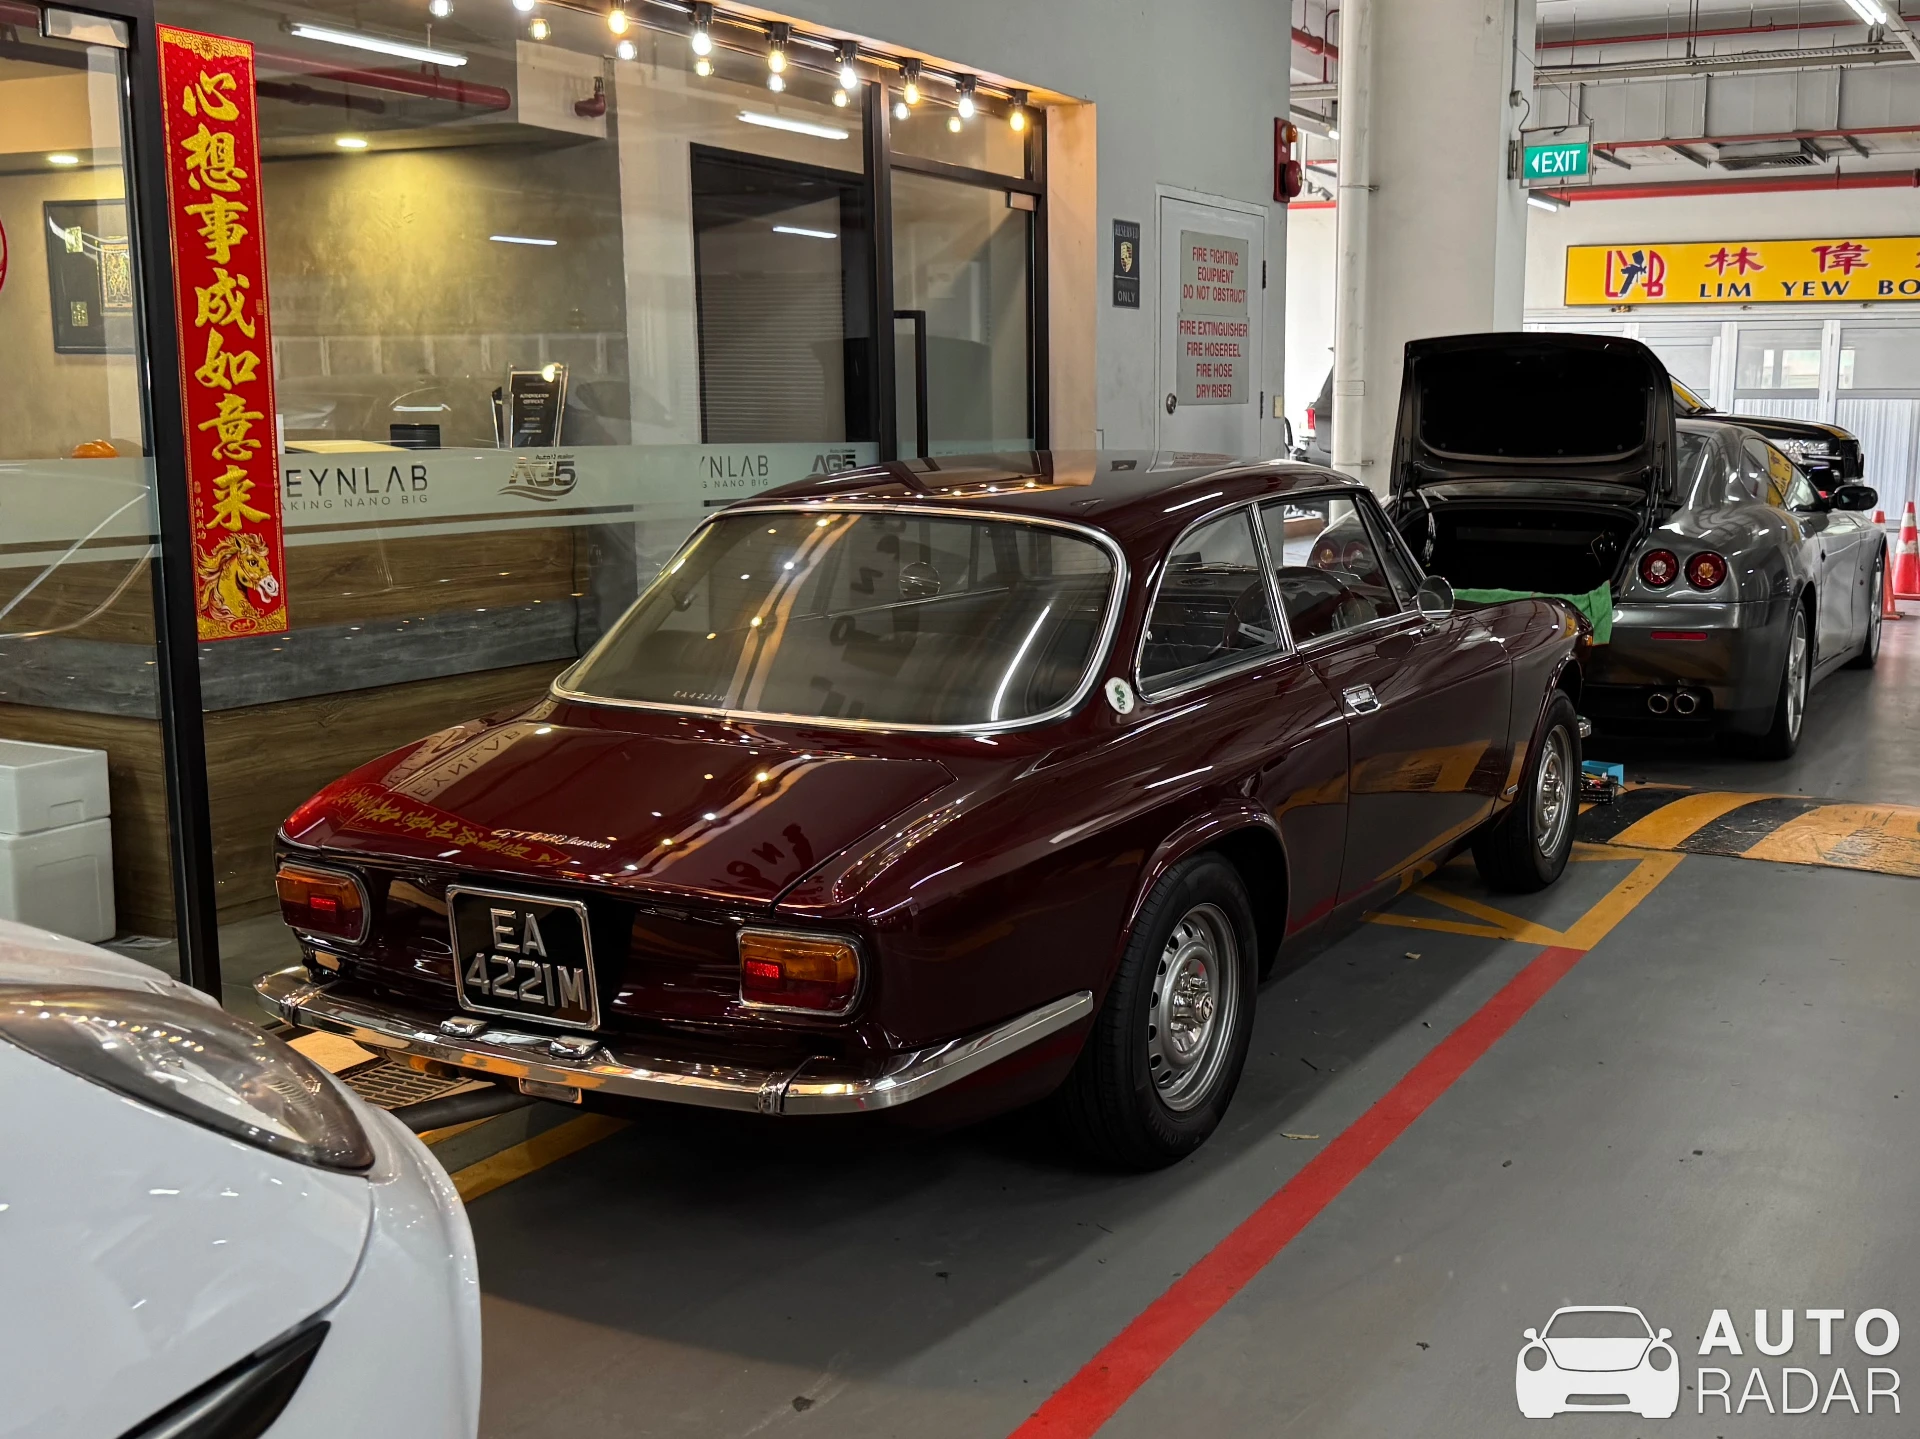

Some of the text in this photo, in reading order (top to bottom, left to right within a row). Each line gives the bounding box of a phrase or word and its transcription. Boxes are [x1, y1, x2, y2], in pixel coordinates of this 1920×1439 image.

[1542, 150, 1581, 173] EXIT
[1192, 247, 1239, 266] FIRE FIGHTING
[1197, 267, 1234, 284] EQUIPMENT
[1118, 291, 1136, 302] ONLY
[1183, 284, 1246, 303] DO NOT OBSTRUCT
[1699, 279, 1920, 298] LIM YEW BO
[181, 69, 272, 532] 心想事成如意来
[1180, 320, 1248, 337] FIRE EXTINGUISHER
[1187, 342, 1241, 357] FIRE HOSEREEL
[1196, 363, 1233, 377] FIRE HOSE
[1196, 384, 1232, 398] DRY RISER
[811, 454, 857, 474] AG5
[714, 480, 745, 489] NANO
[752, 479, 769, 487] BIG
[344, 496, 391, 508] NANO
[402, 494, 428, 504] BIG
[490, 907, 548, 958] EA
[465, 952, 588, 1012] 4221M
